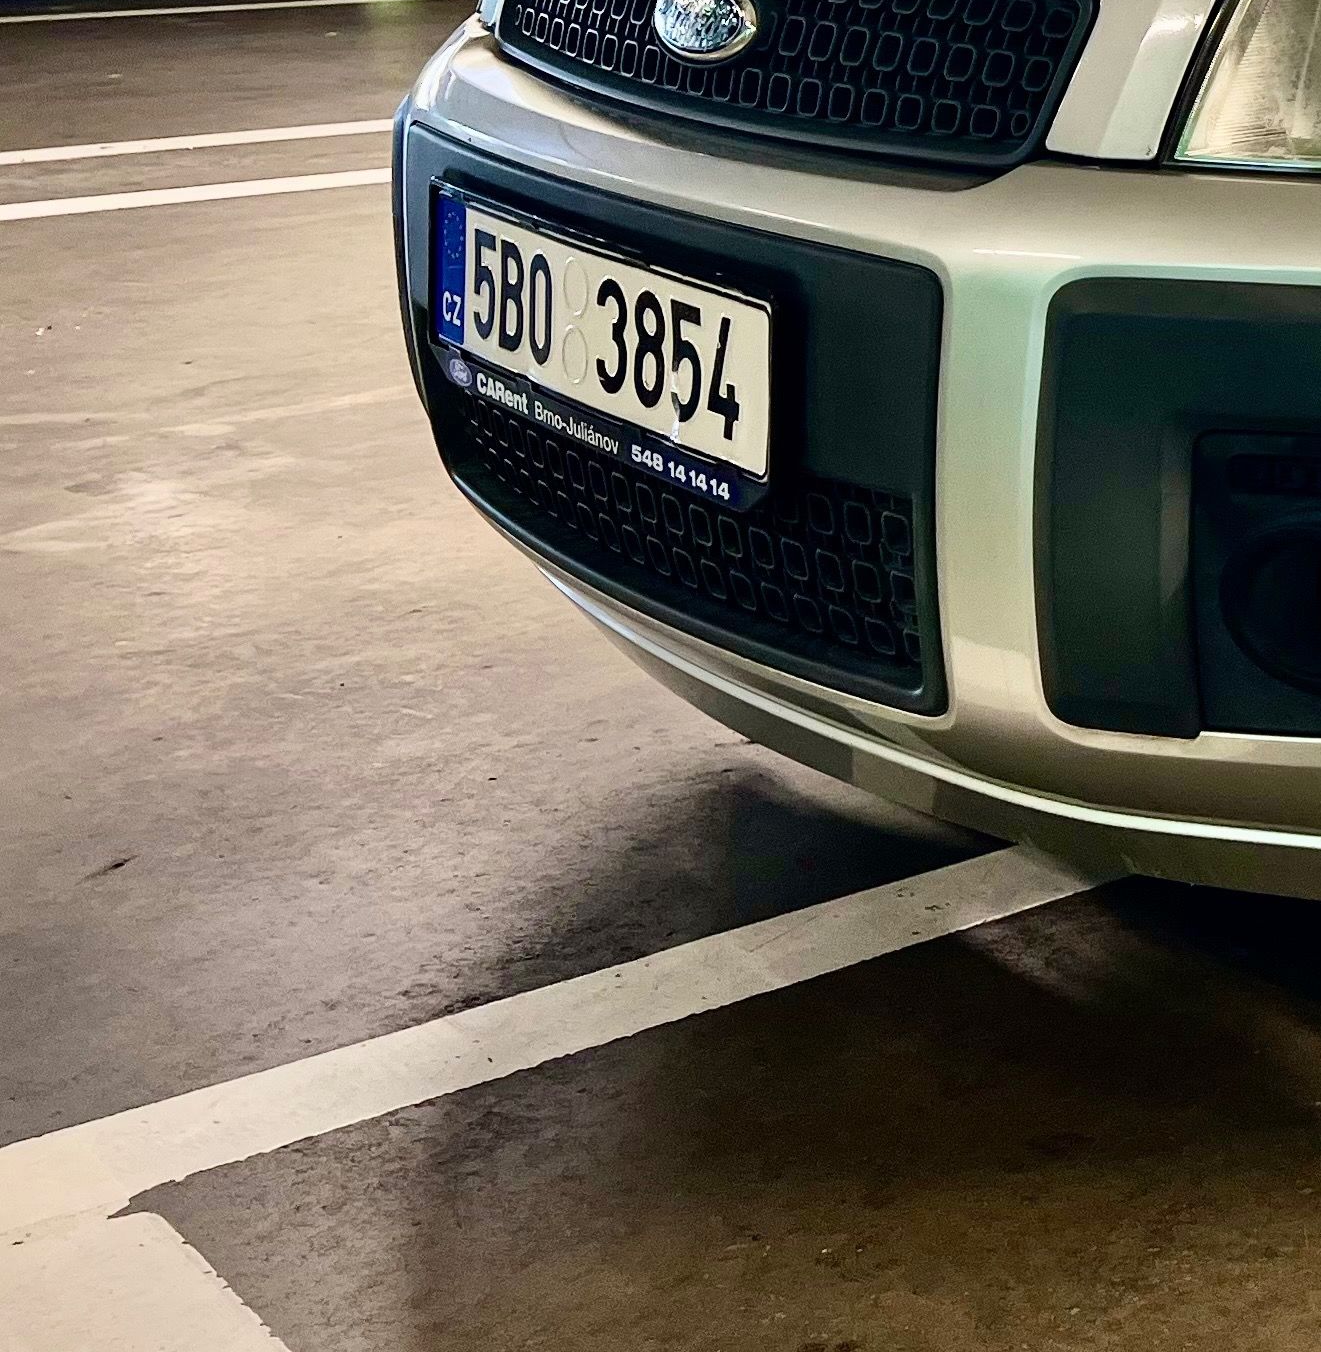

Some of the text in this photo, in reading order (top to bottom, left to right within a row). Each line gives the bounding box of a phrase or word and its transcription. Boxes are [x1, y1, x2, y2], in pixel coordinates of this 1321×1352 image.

[442, 290, 462, 327] CZ
[473, 228, 740, 442] 5B0 3854
[476, 372, 529, 415] CARent
[534, 400, 619, 455] Brno-Juliánov
[631, 444, 664, 472] 548
[668, 461, 687, 483] 14
[689, 469, 707, 492] 14
[709, 478, 730, 500] 14
